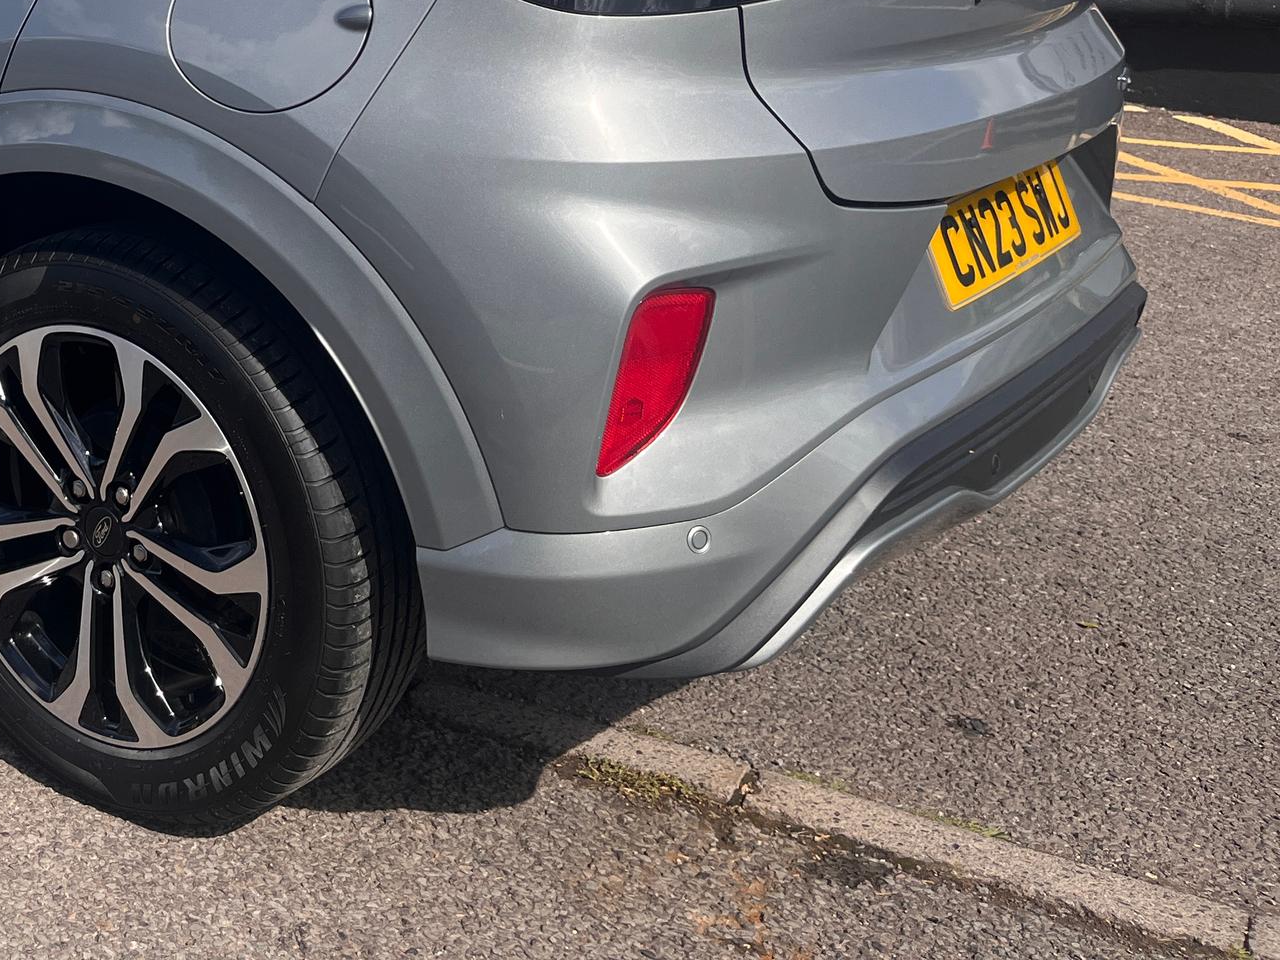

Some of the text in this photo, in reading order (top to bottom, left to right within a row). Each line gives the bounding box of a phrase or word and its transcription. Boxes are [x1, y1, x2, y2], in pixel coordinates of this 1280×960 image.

[940, 164, 1070, 287] CN23 SWJ
[131, 723, 272, 803] WINRUN
